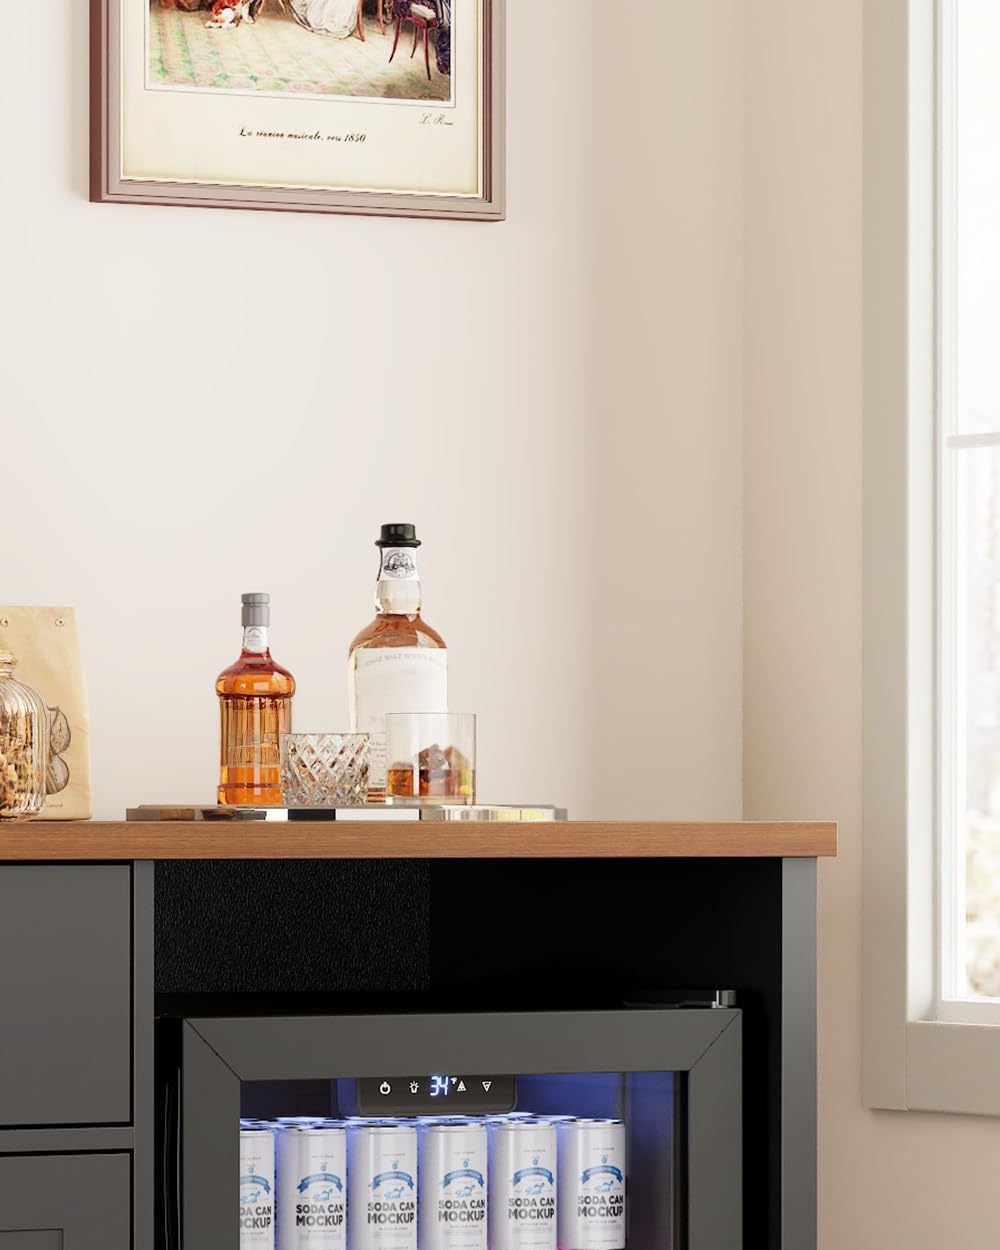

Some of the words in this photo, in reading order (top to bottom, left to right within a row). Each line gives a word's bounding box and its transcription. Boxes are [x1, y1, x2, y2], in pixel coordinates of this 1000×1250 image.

[344, 133, 366, 143] 1850
[430, 1076, 449, 1096] 34
[439, 1200, 467, 1209] SODA
[470, 1199, 486, 1209] CAN
[508, 1198, 537, 1207] SODA
[540, 1197, 555, 1207] CAN
[577, 1195, 607, 1205] SODA
[609, 1195, 624, 1204] CAN
[240, 1207, 253, 1216] DA
[255, 1206, 272, 1216] CAN
[296, 1204, 325, 1214] SODA
[327, 1204, 344, 1214] CAN
[367, 1202, 397, 1211] SODA
[399, 1202, 415, 1211] CAN
[577, 1205, 624, 1217] MOCKUP
[367, 1212, 415, 1224] MOCKUP
[439, 1210, 485, 1222] MOCKUP
[508, 1207, 555, 1219] MOCKUP
[296, 1215, 344, 1226] MOCKUP
